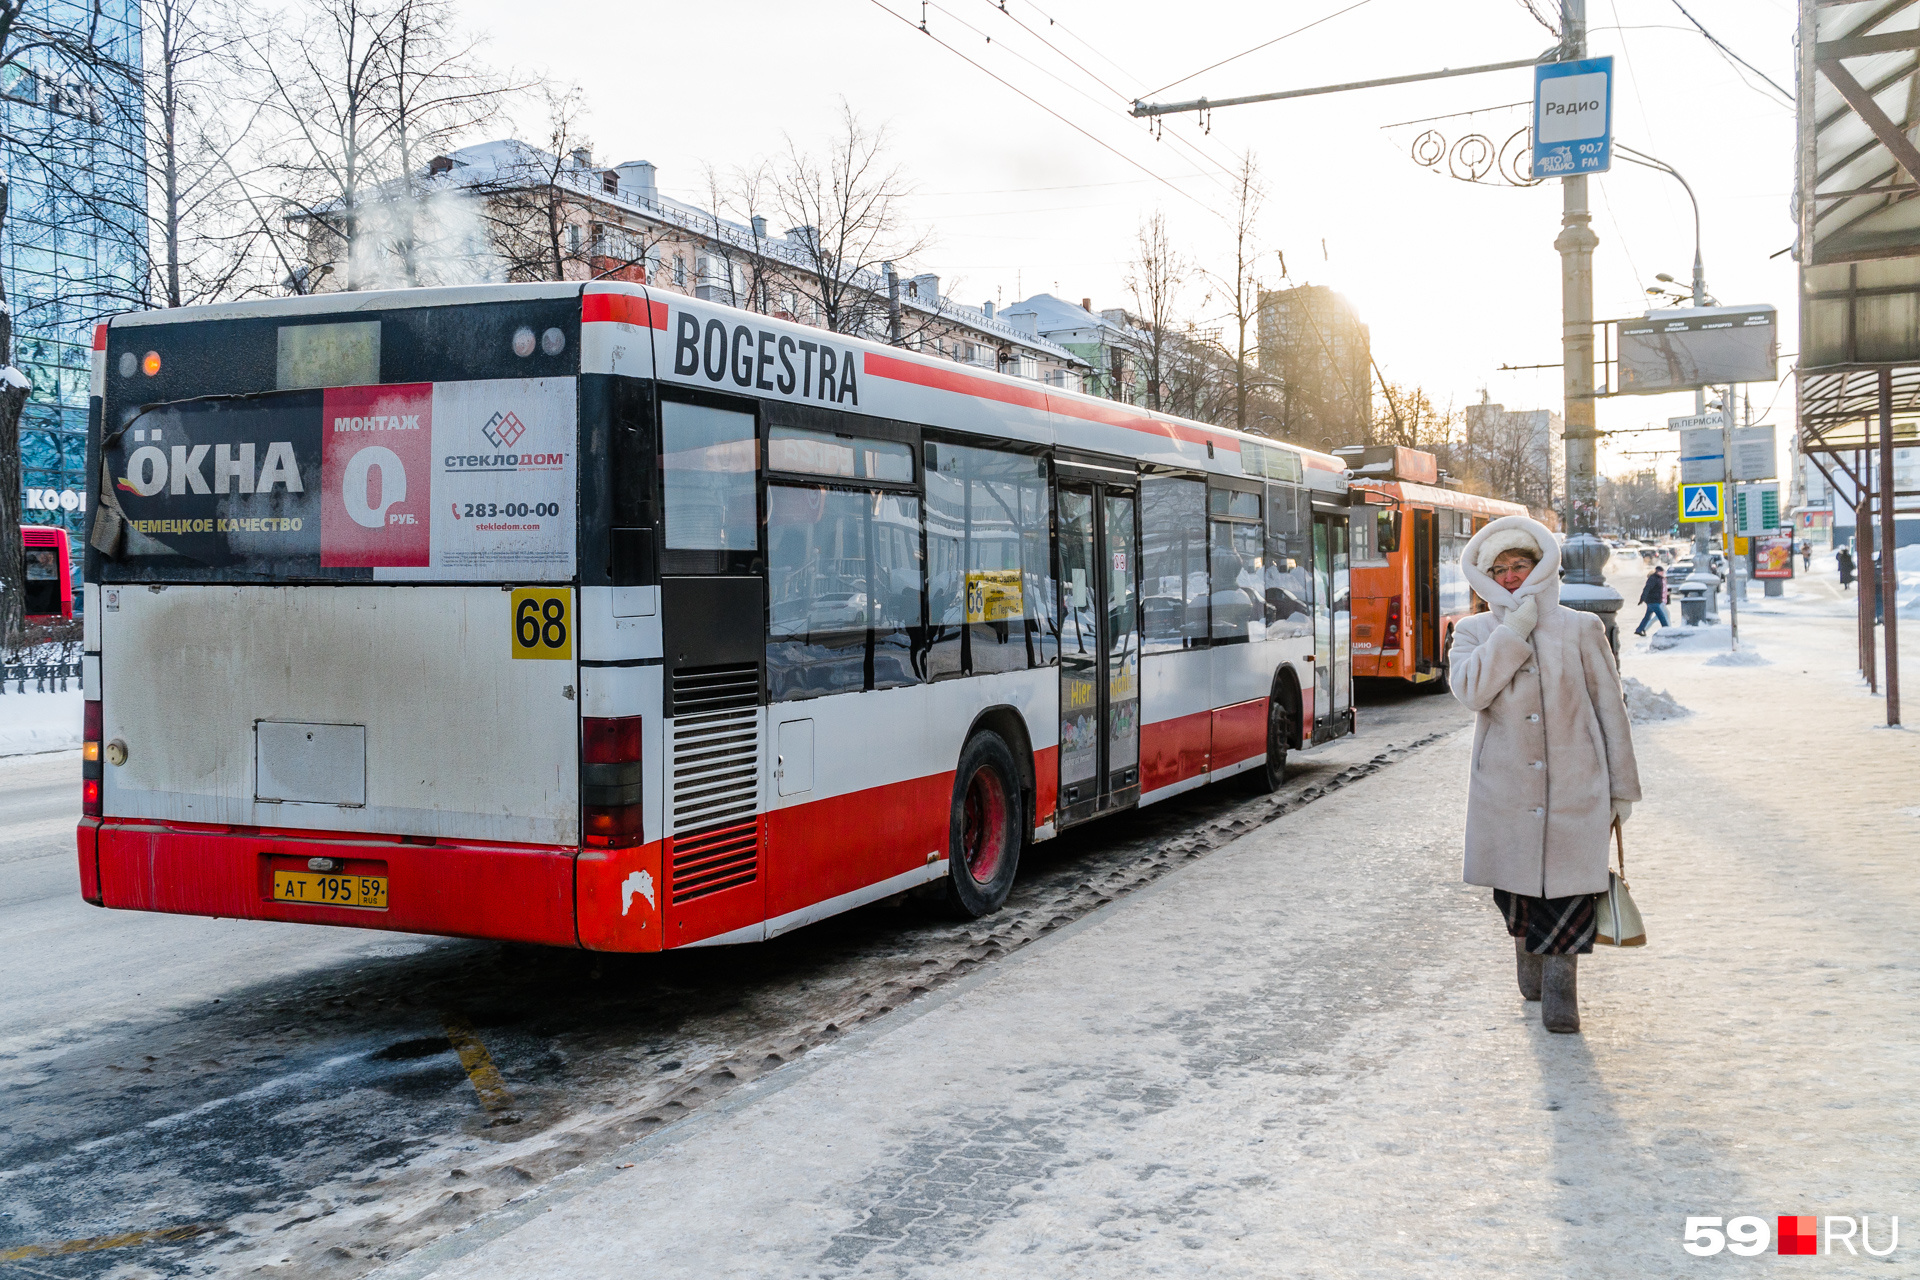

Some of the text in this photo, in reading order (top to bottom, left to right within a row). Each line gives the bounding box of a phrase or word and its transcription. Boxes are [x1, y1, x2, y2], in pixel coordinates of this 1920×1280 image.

[1546, 100, 1599, 115] Радио
[1579, 142, 1604, 154] 90,7
[1537, 156, 1562, 166] АВТО
[1543, 161, 1575, 173] РАДИО
[1581, 157, 1599, 168] FM
[674, 311, 859, 406] BOGESTRA
[334, 414, 420, 432] МОНТАЖ
[1669, 416, 1723, 430] ул.ПЕРМСКА
[342, 445, 407, 528] 0
[464, 502, 559, 518] 283-00-00
[217, 517, 303, 532] КАЧЕСТВО
[389, 513, 419, 525] РУБ.
[475, 522, 540, 531] steklodom.com
[967, 580, 984, 614] 68
[515, 597, 567, 649] 68
[1071, 679, 1092, 709] Hier
[285, 877, 381, 901] АТ 195 59
